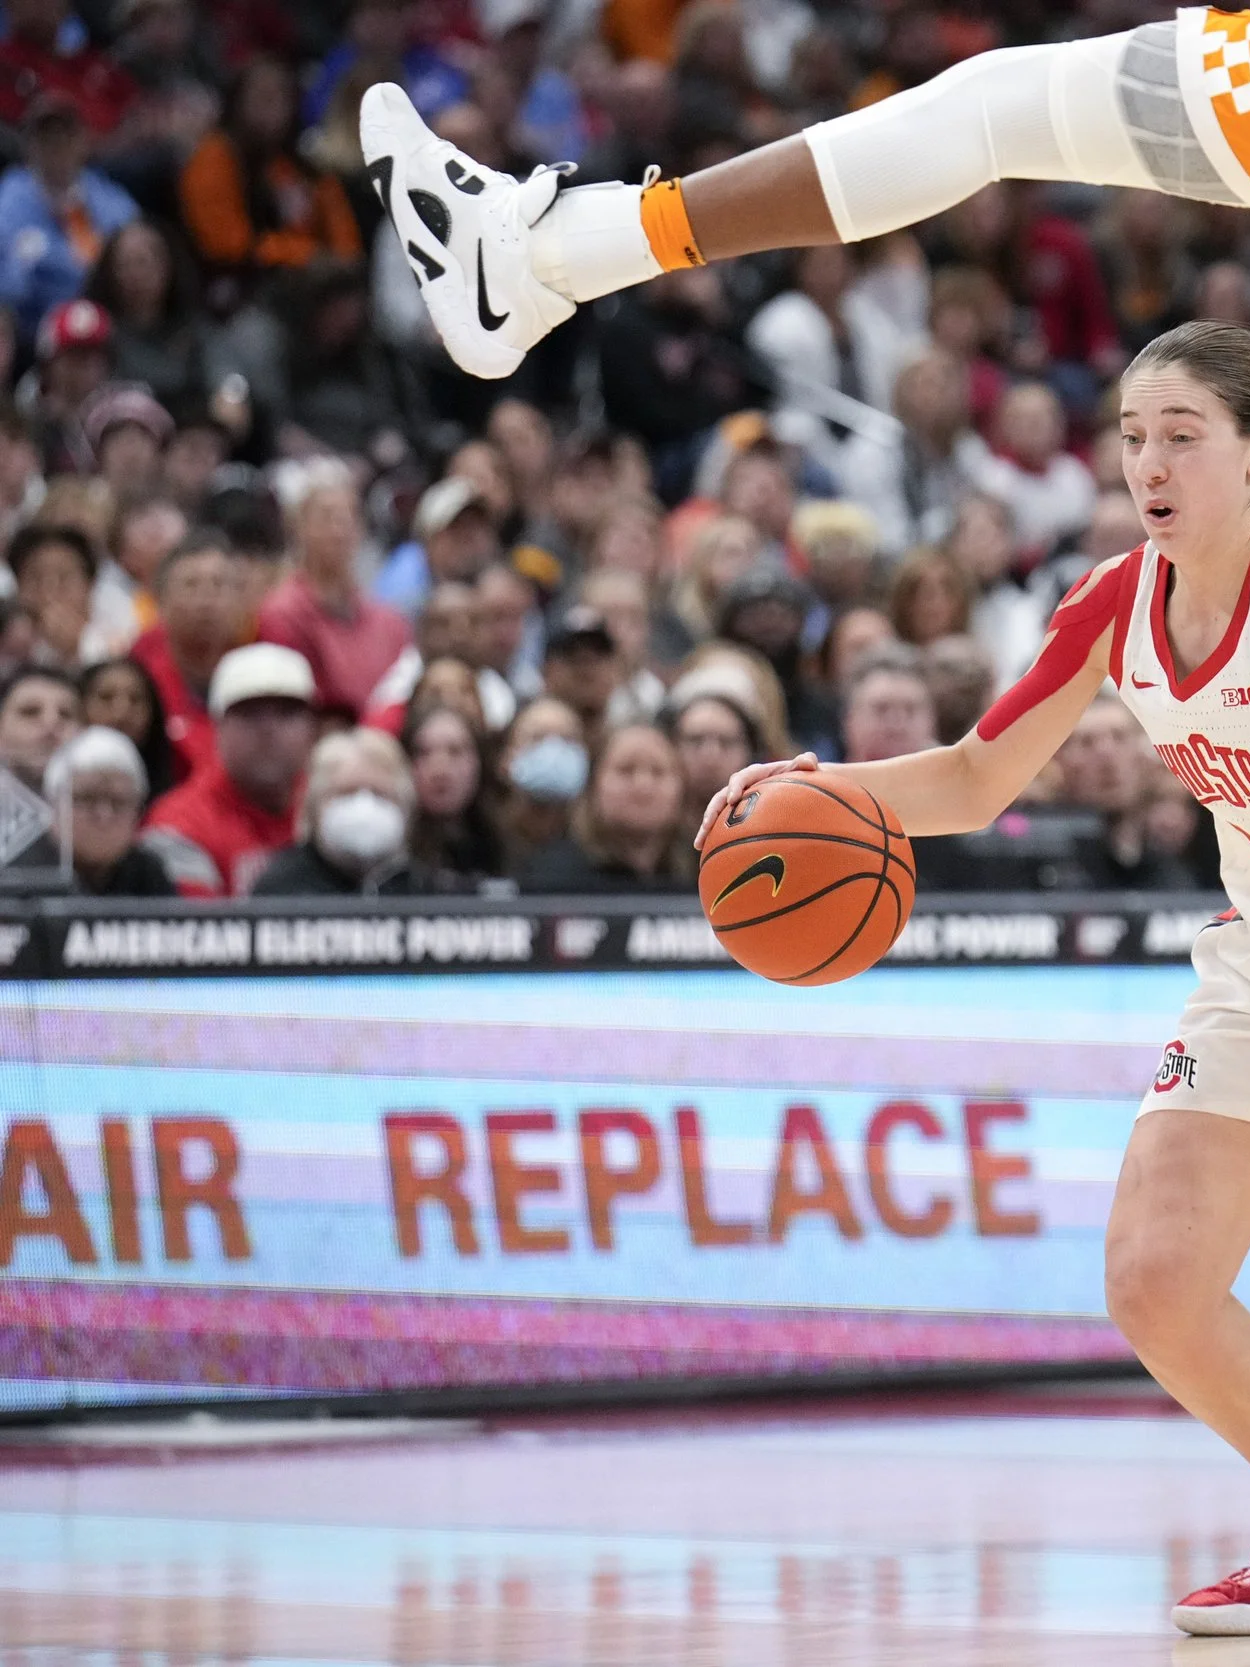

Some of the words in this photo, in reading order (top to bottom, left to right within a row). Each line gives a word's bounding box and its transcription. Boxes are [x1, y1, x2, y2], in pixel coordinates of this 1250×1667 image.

[63, 918, 250, 967] AMERICAN
[253, 917, 403, 965] ELECTRIC
[405, 916, 534, 963] POWER
[383, 1098, 1042, 1260] REPLACE
